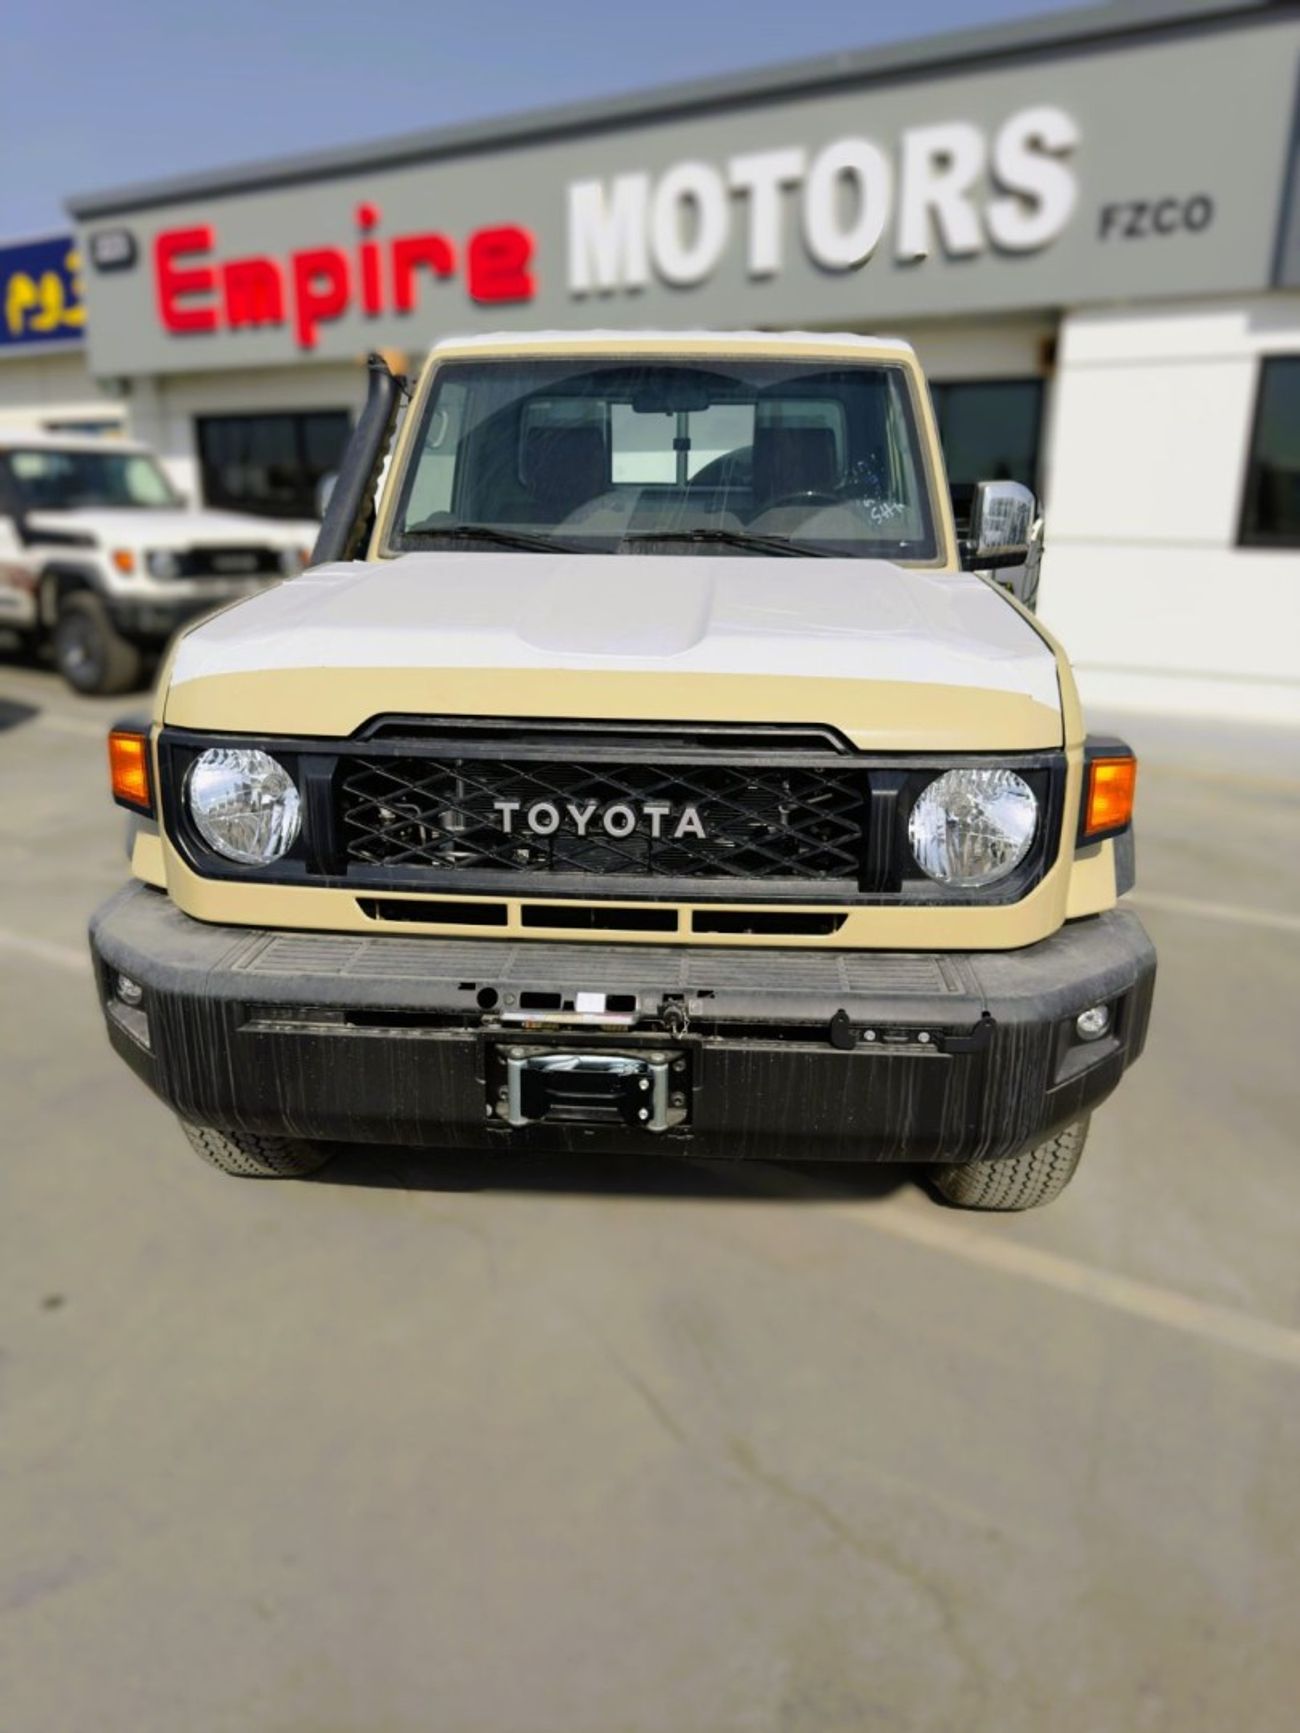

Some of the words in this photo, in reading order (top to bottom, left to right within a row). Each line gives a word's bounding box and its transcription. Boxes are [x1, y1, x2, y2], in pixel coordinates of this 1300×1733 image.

[154, 204, 536, 348] Empire
[567, 107, 1078, 296] MOTORS
[1098, 195, 1215, 243] FZCO
[493, 801, 706, 839] TOYOTA
